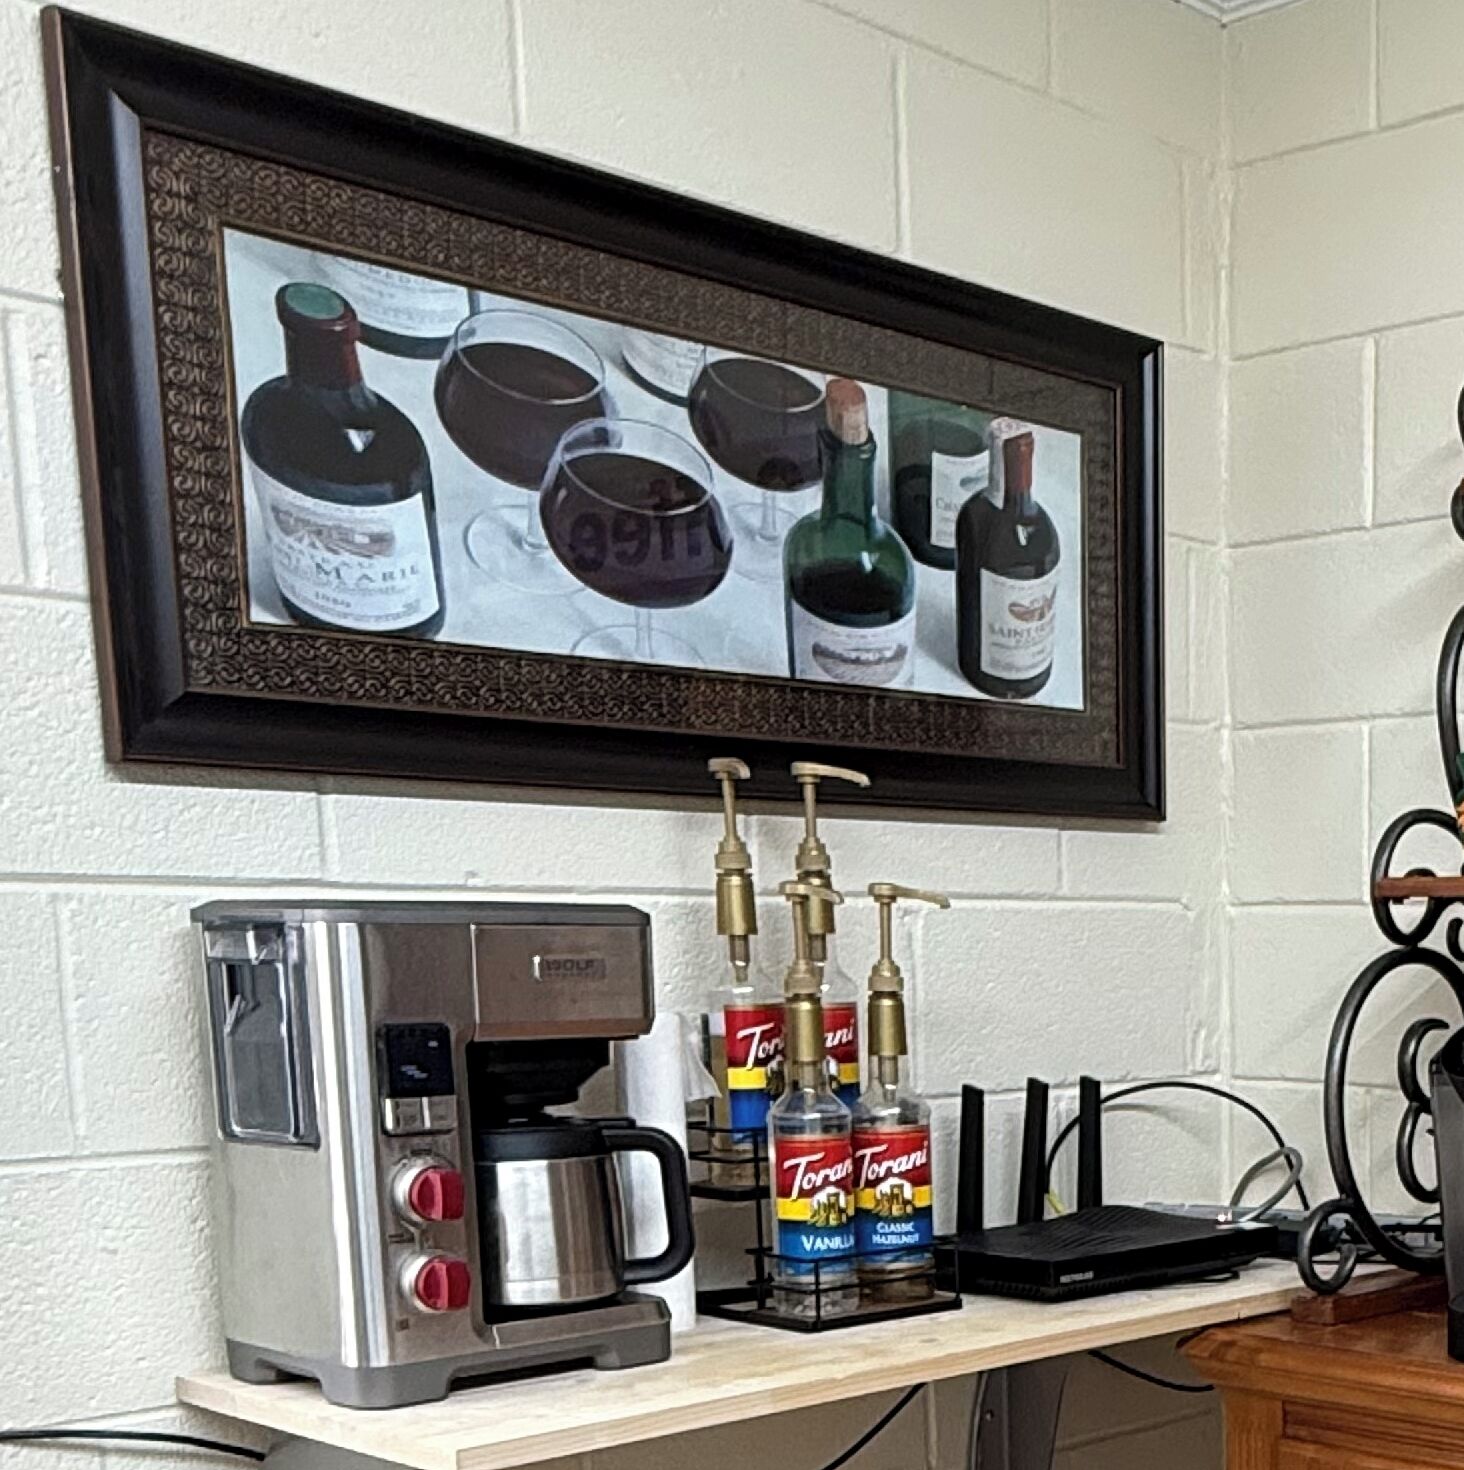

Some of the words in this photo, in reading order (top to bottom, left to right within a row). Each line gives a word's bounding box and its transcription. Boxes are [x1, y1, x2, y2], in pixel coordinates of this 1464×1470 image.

[736, 1022, 785, 1070] Tor
[783, 1152, 853, 1201] Toran
[855, 1140, 928, 1189] Torani
[871, 1233, 919, 1244] HAZELNUT
[876, 1221, 914, 1233] CLASSIC
